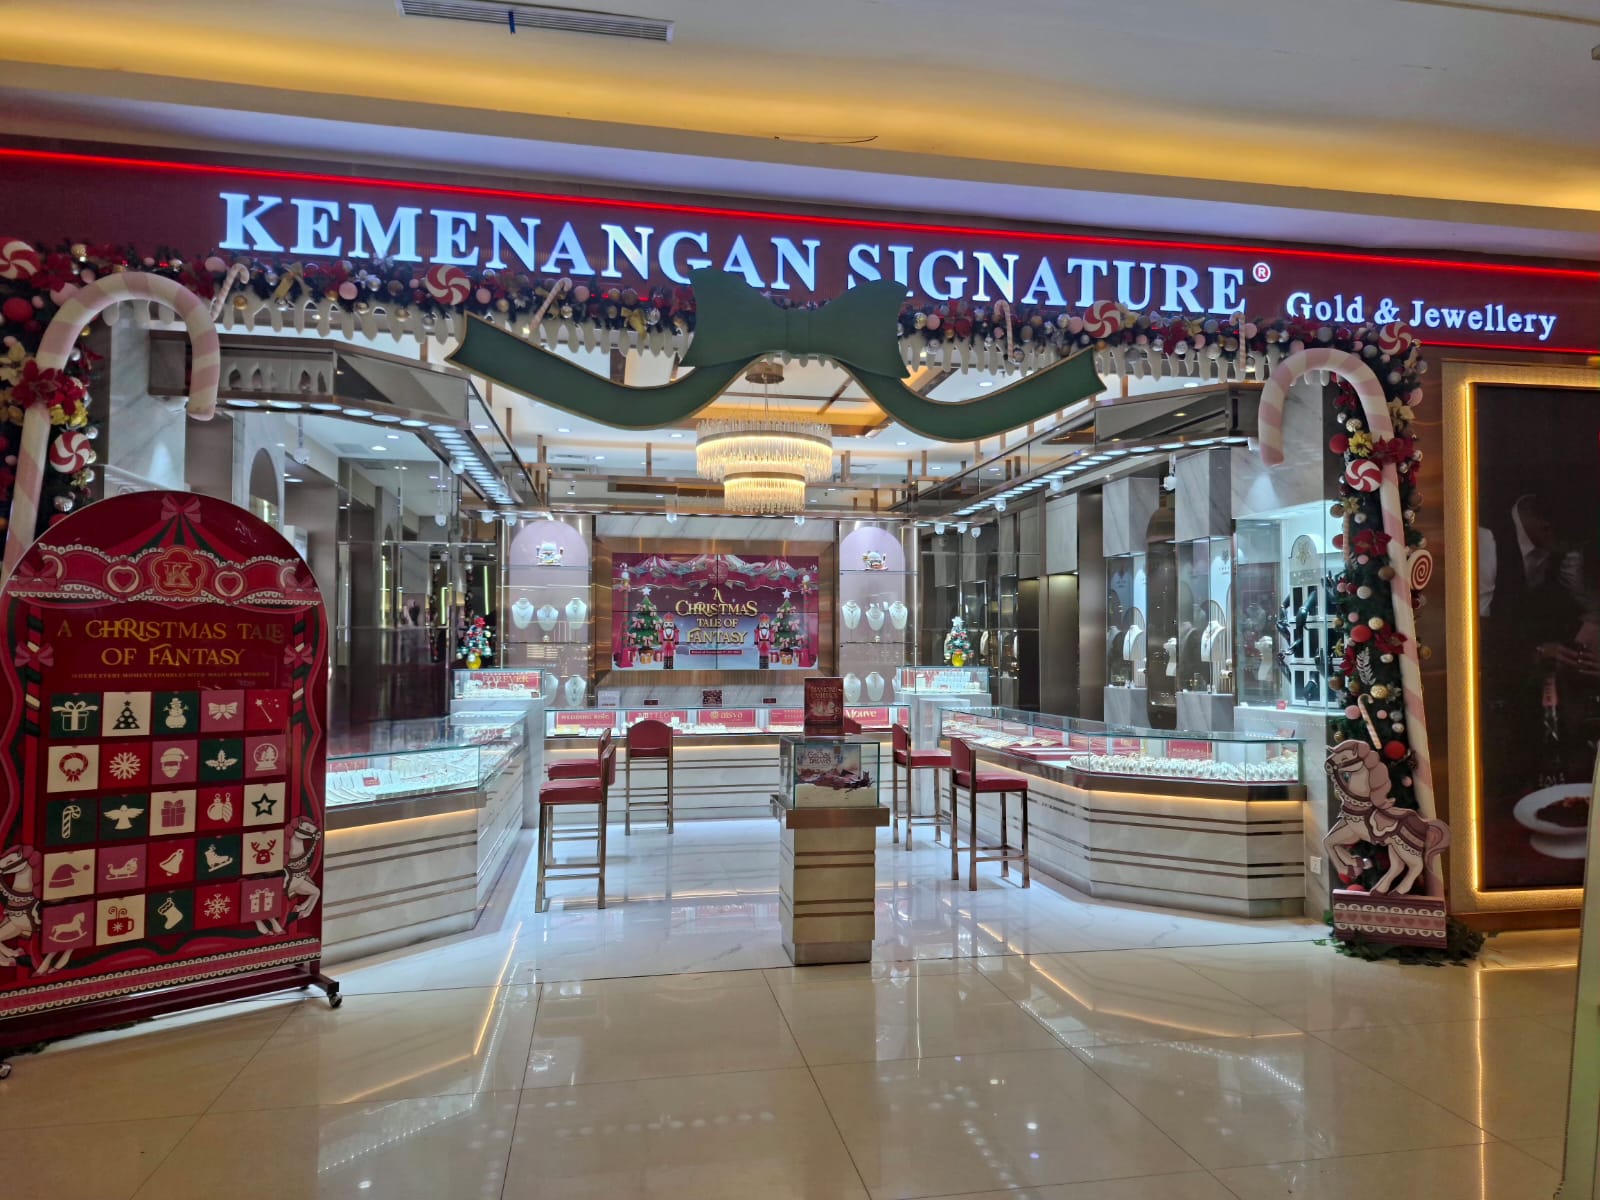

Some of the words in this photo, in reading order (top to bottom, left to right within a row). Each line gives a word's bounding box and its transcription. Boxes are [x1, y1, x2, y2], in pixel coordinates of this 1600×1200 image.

[218, 191, 821, 292] KEMENANGAN
[1286, 291, 1365, 323] Gold
[1374, 297, 1400, 325] &
[1409, 300, 1557, 341] Jewellery
[675, 600, 758, 617] CHRISTMAS
[57, 621, 72, 637] A
[85, 617, 227, 642] CHRISTMAS
[237, 622, 284, 644] TALE
[697, 618, 721, 628] TALE
[723, 618, 739, 628] OF
[686, 628, 748, 644] FANTASY
[101, 648, 137, 666] OF
[149, 643, 245, 666] FANTASY
